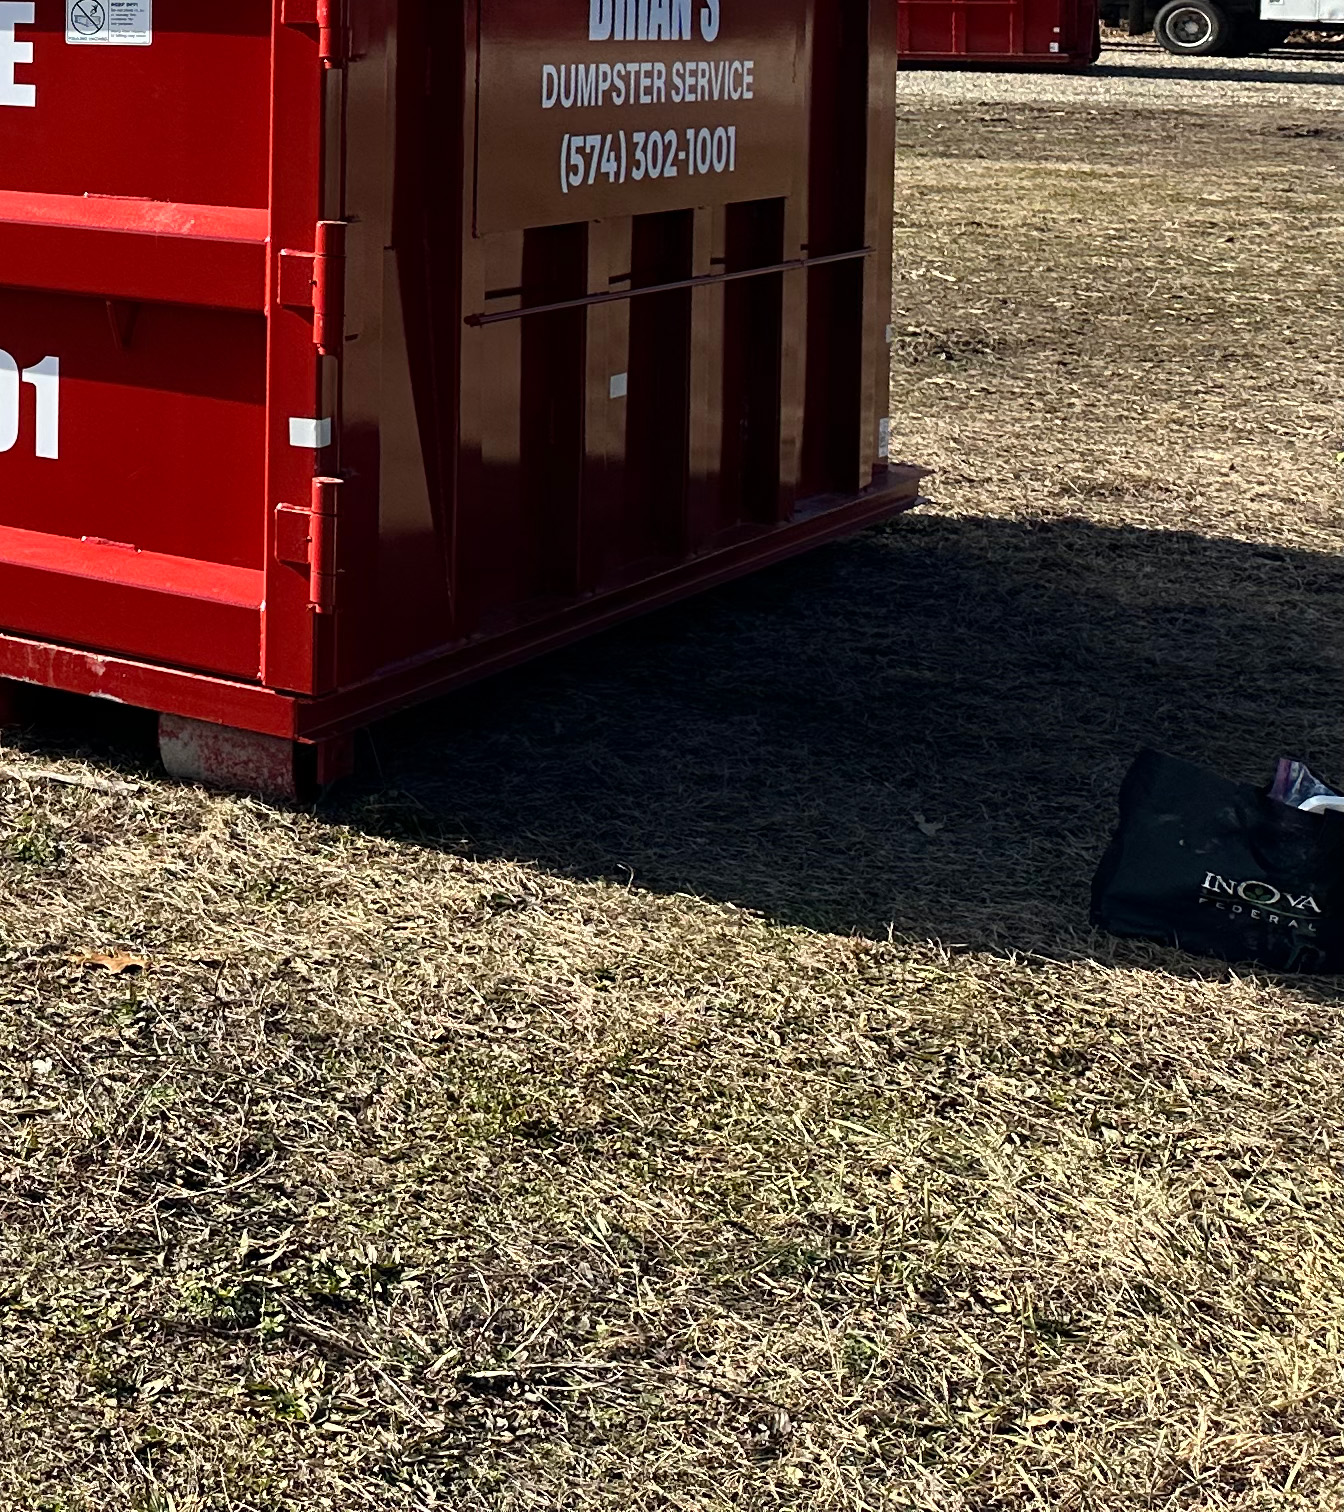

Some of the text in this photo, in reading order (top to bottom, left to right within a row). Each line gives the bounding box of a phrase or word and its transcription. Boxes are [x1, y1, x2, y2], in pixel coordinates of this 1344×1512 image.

[541, 60, 754, 109] DUMPSTER SERVICE
[560, 126, 736, 193] (574) 302-1001
[1201, 870, 1322, 913] INOVA
